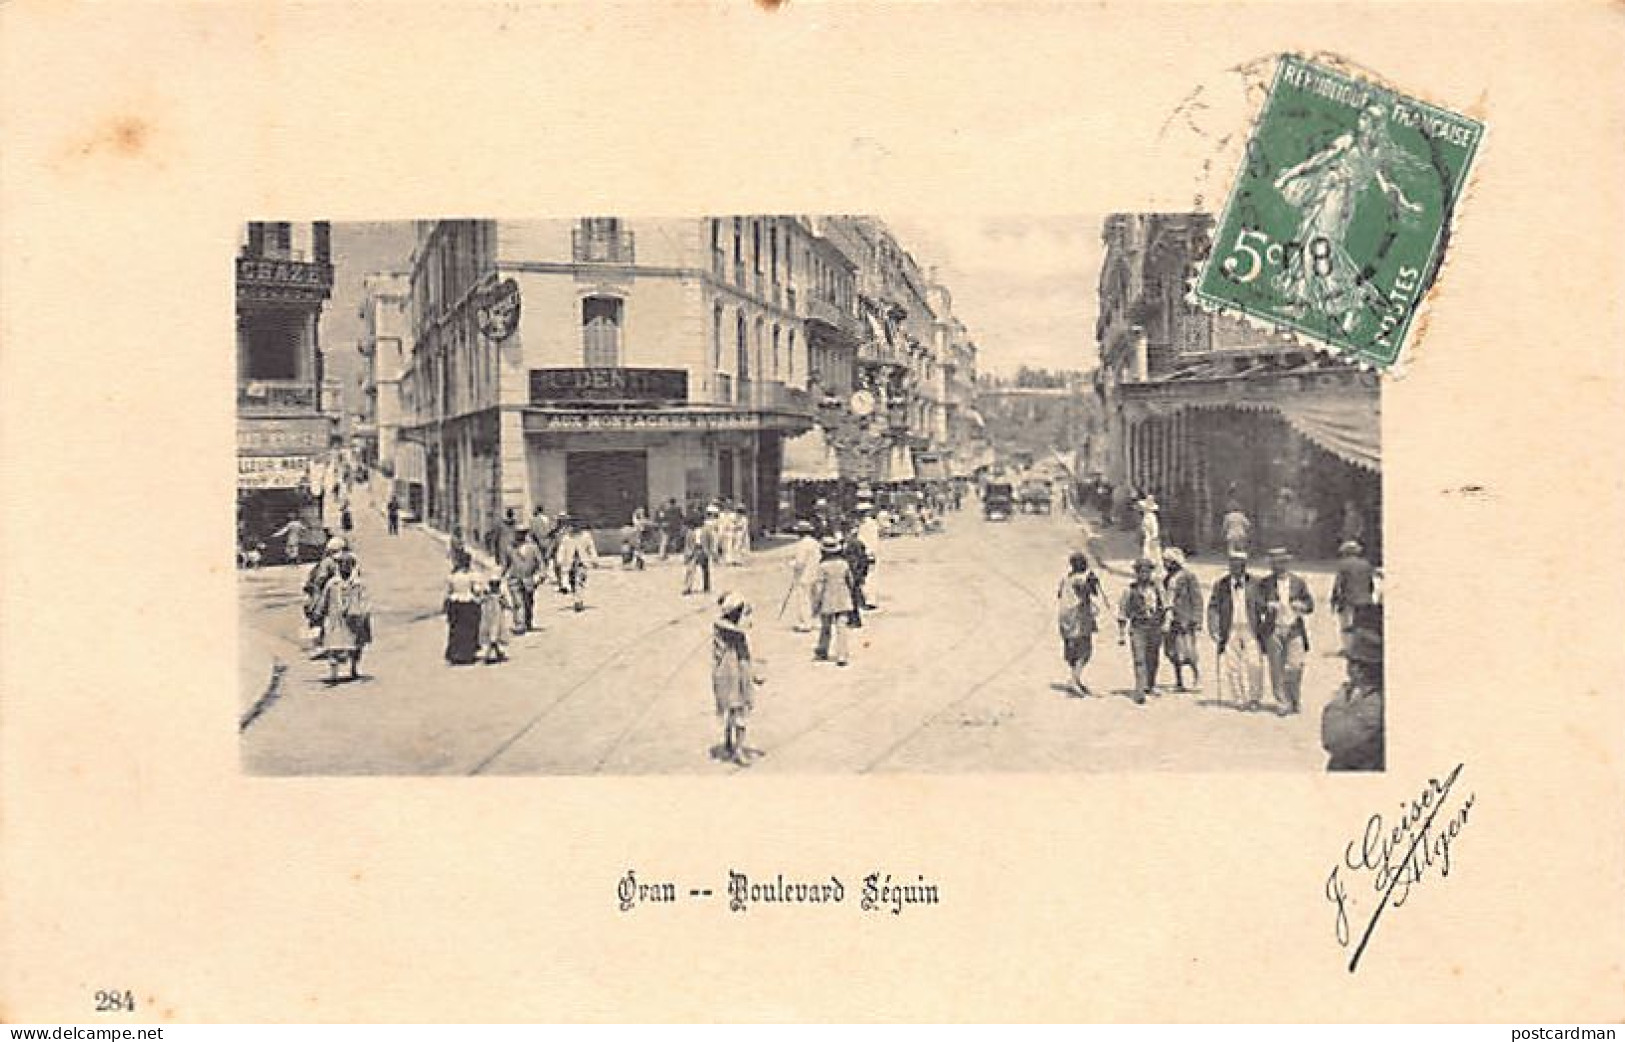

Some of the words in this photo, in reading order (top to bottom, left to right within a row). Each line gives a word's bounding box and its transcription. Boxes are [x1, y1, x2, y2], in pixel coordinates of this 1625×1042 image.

[1377, 265, 1419, 347] POSTES
[1346, 778, 1442, 892] Geiser
[1394, 791, 1477, 907] Alger
[617, 869, 676, 911] Oran
[728, 868, 845, 911] Boulevard
[860, 870, 940, 915] Séguin
[94, 989, 135, 1012] 284
